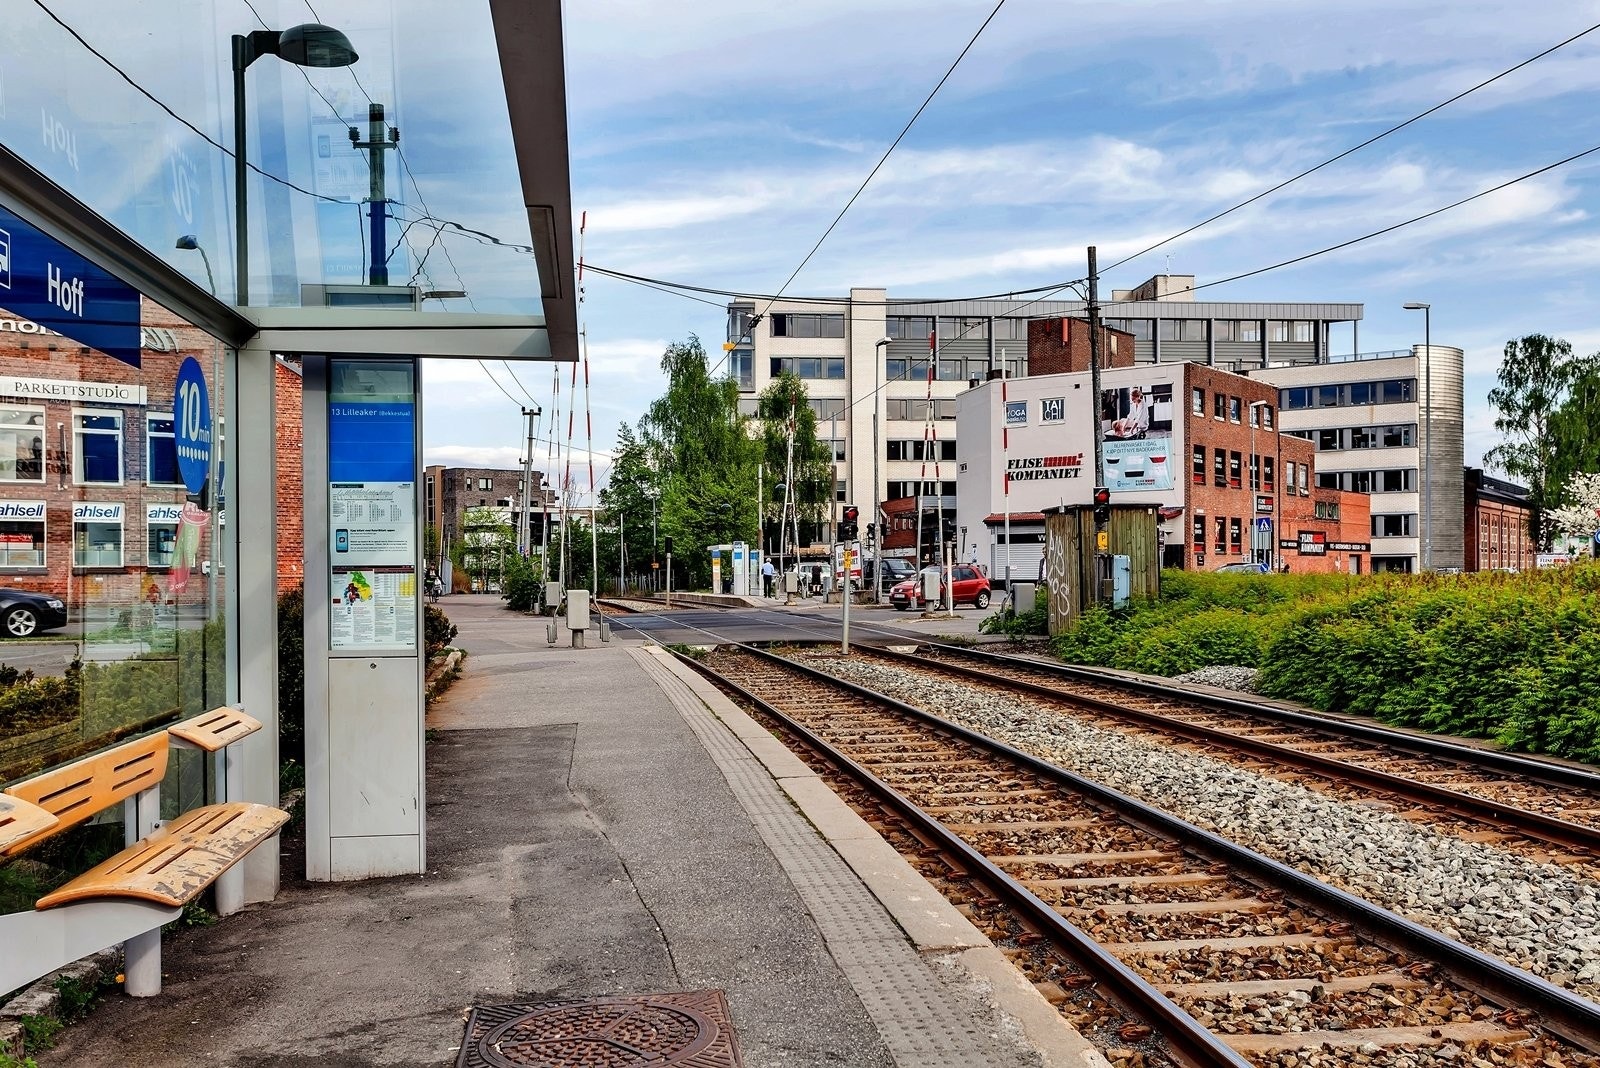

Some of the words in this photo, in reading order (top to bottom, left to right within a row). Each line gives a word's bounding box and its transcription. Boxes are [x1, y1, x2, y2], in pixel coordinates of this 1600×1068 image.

[47, 262, 84, 317] Hoff
[179, 380, 201, 442] 10
[198, 427, 211, 443] min
[331, 408, 341, 416] 13
[342, 408, 378, 416] Lilleaker
[1045, 400, 1062, 411] TAI
[1044, 408, 1061, 420] CHI
[1007, 457, 1044, 470] FLISE
[1007, 468, 1082, 481] KOMPANIET
[0, 504, 44, 517] ahlsell
[74, 505, 120, 518] ahlsell
[148, 506, 183, 519] ahlse
